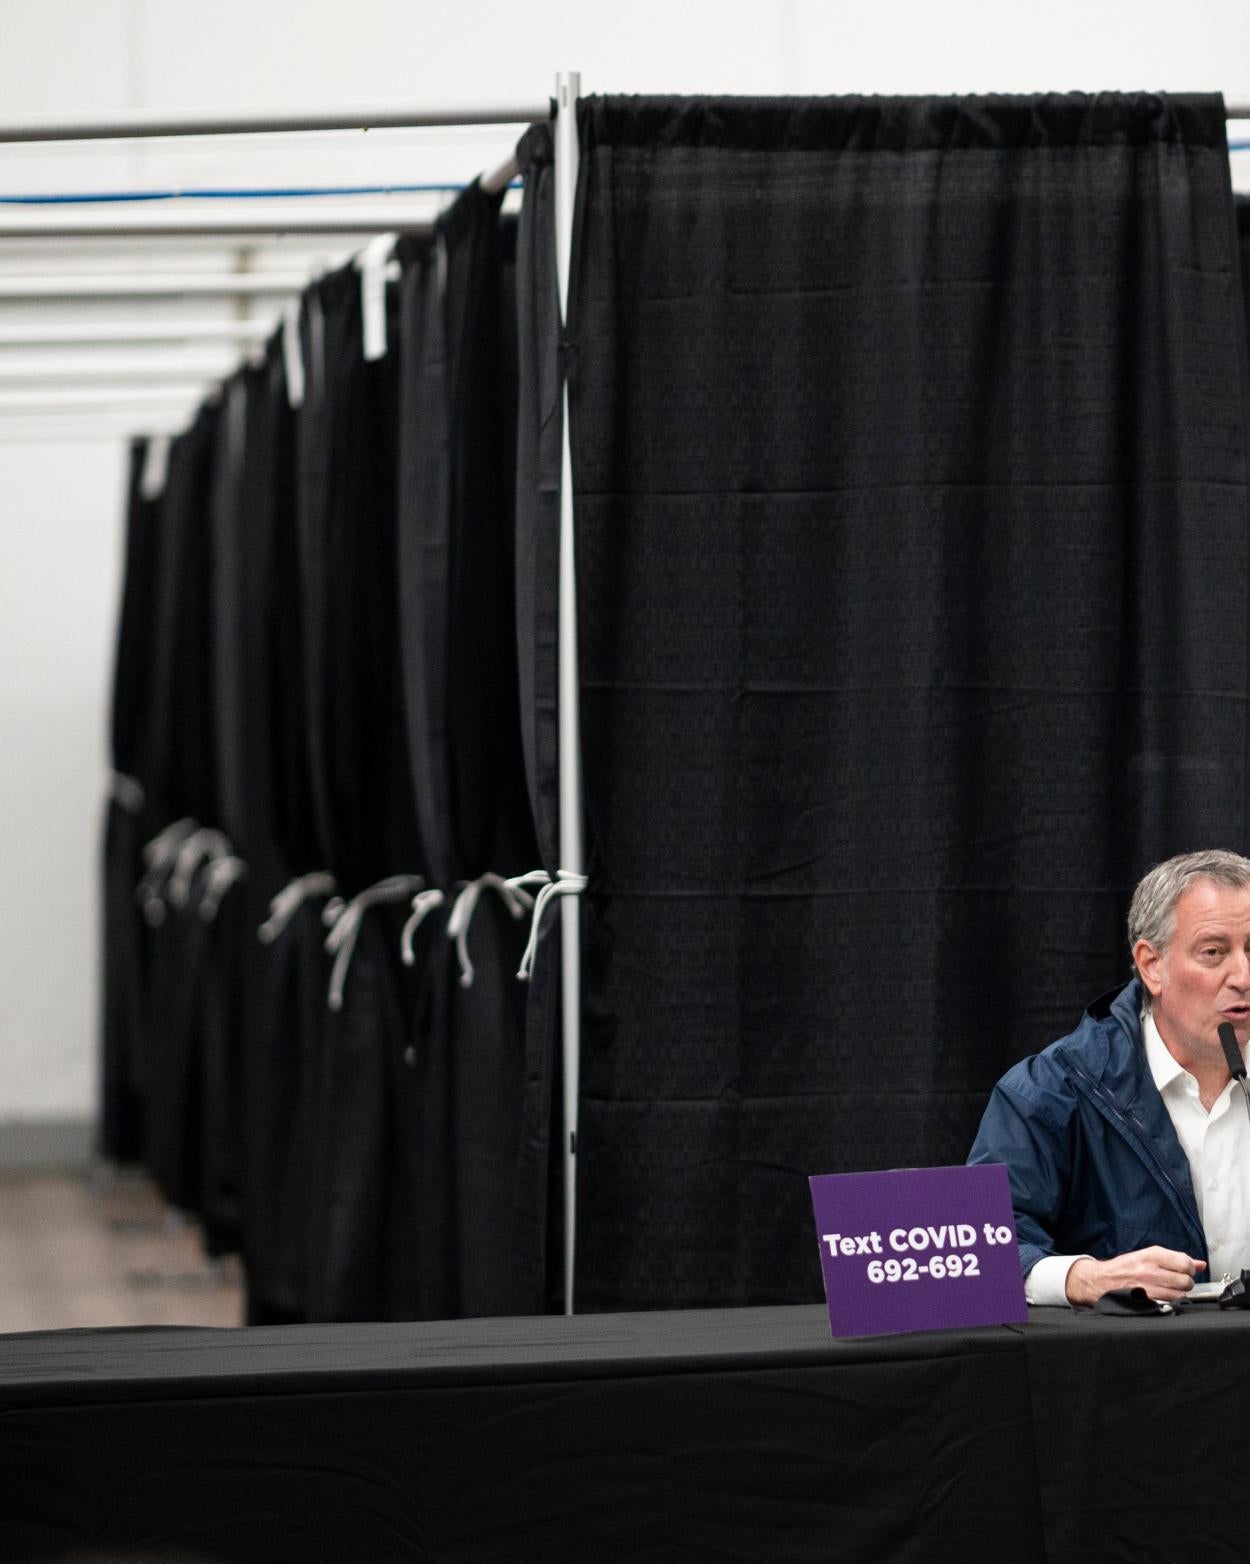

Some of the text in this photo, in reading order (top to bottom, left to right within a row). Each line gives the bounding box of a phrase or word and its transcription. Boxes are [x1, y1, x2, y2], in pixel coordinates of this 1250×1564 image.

[822, 1223, 1013, 1257] Text COVID to
[866, 1253, 981, 1284] 692-692
